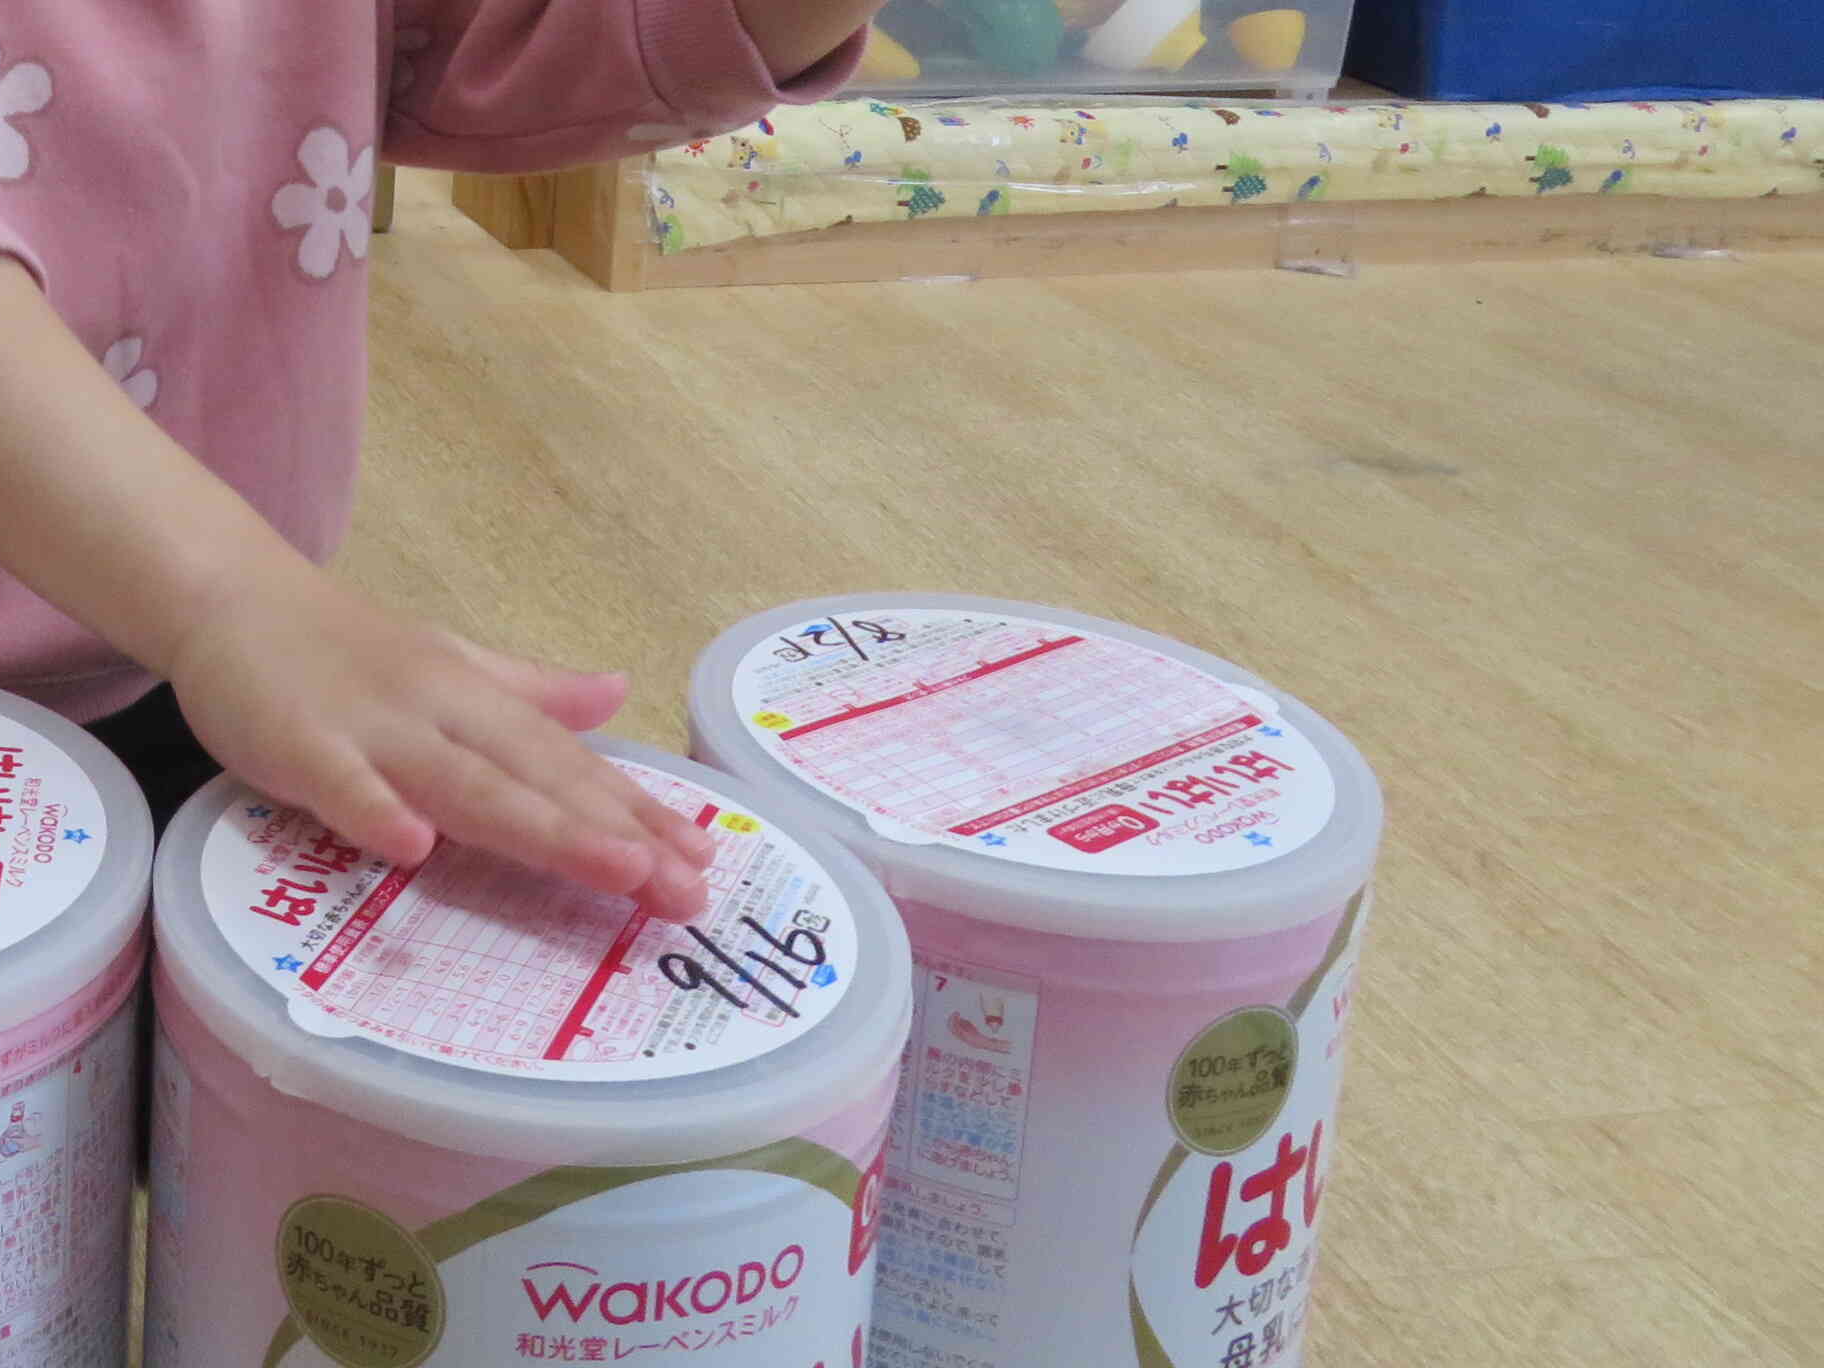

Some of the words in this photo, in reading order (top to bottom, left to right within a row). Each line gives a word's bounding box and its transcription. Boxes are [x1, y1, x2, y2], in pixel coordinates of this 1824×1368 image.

[1137, 750, 1296, 816] はいはい
[249, 829, 363, 927] はいは
[658, 915, 826, 1018] 9/16
[935, 975, 948, 992] 7
[287, 1249, 432, 1334] 赤ちゃん品質
[293, 1224, 428, 1301] 100年ずっと
[515, 1295, 800, 1362] 和光堂レーベンスミルク
